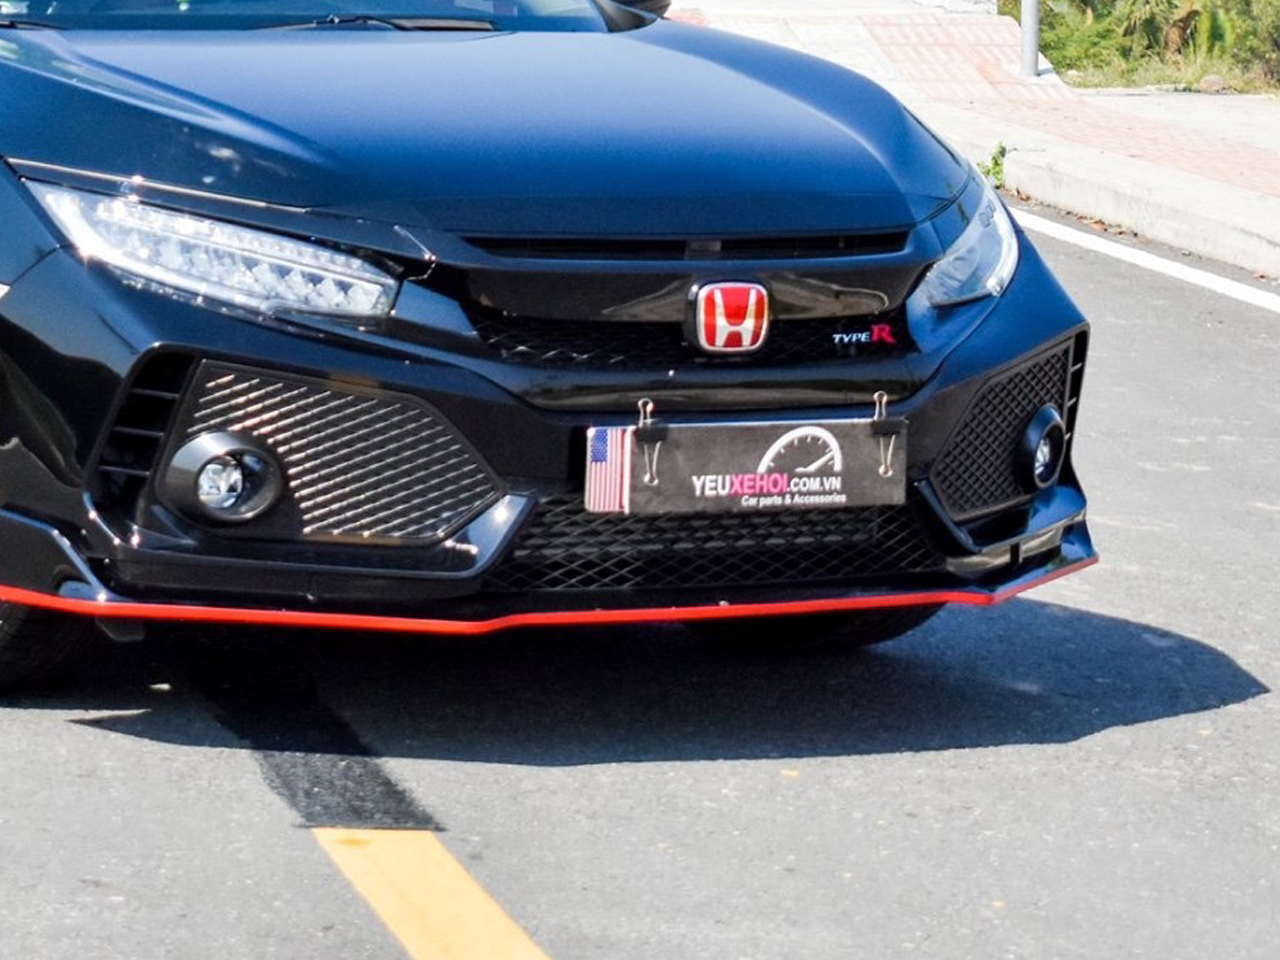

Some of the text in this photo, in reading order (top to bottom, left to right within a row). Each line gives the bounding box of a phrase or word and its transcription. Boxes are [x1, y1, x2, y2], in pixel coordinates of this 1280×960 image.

[741, 492, 847, 508] Car parts & Accessories
